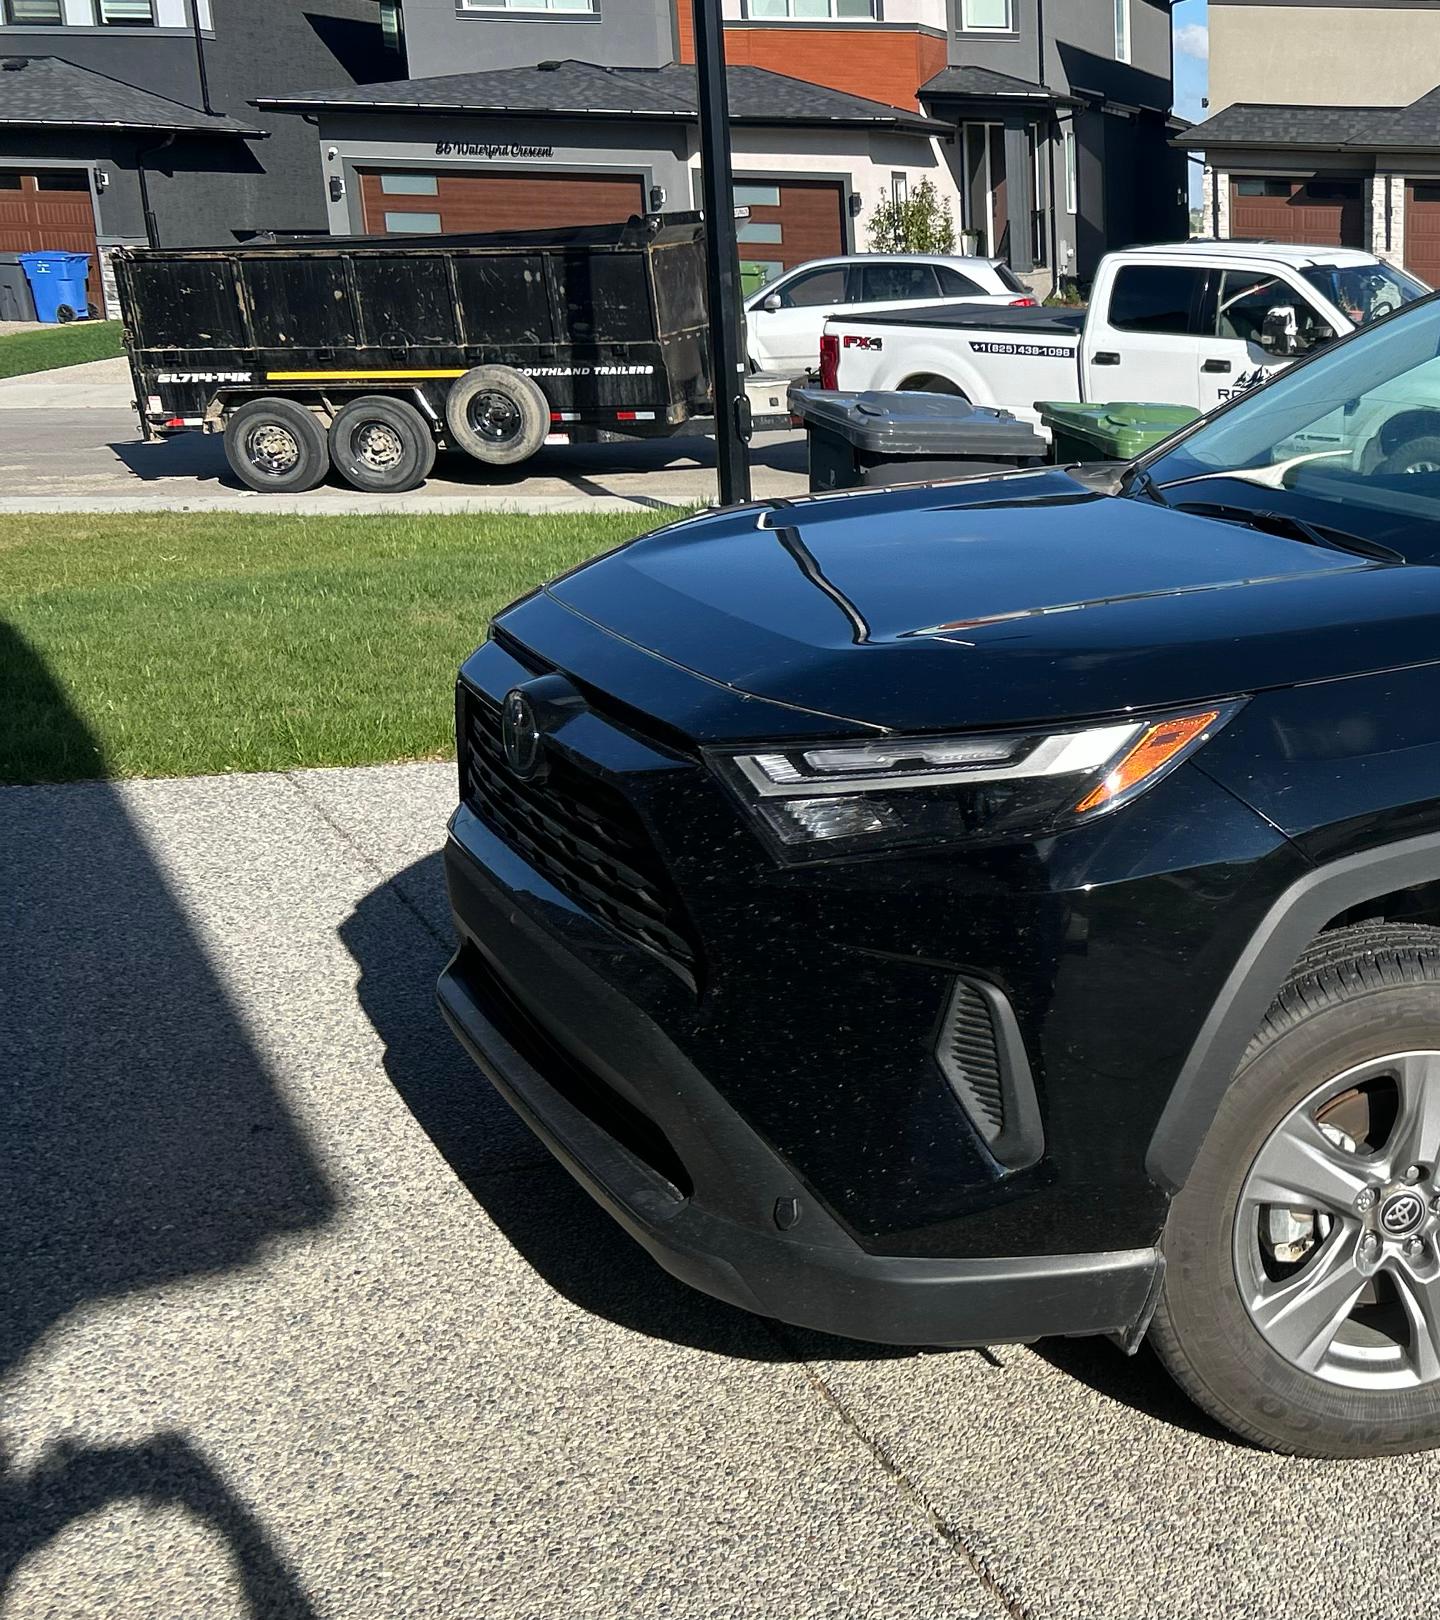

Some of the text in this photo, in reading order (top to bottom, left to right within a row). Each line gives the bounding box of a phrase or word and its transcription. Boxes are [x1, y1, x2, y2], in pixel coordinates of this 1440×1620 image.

[453, 141, 509, 159] Waterford
[510, 142, 554, 157] Crescent
[843, 335, 883, 349] FX4
[594, 365, 654, 375] TRAILERS
